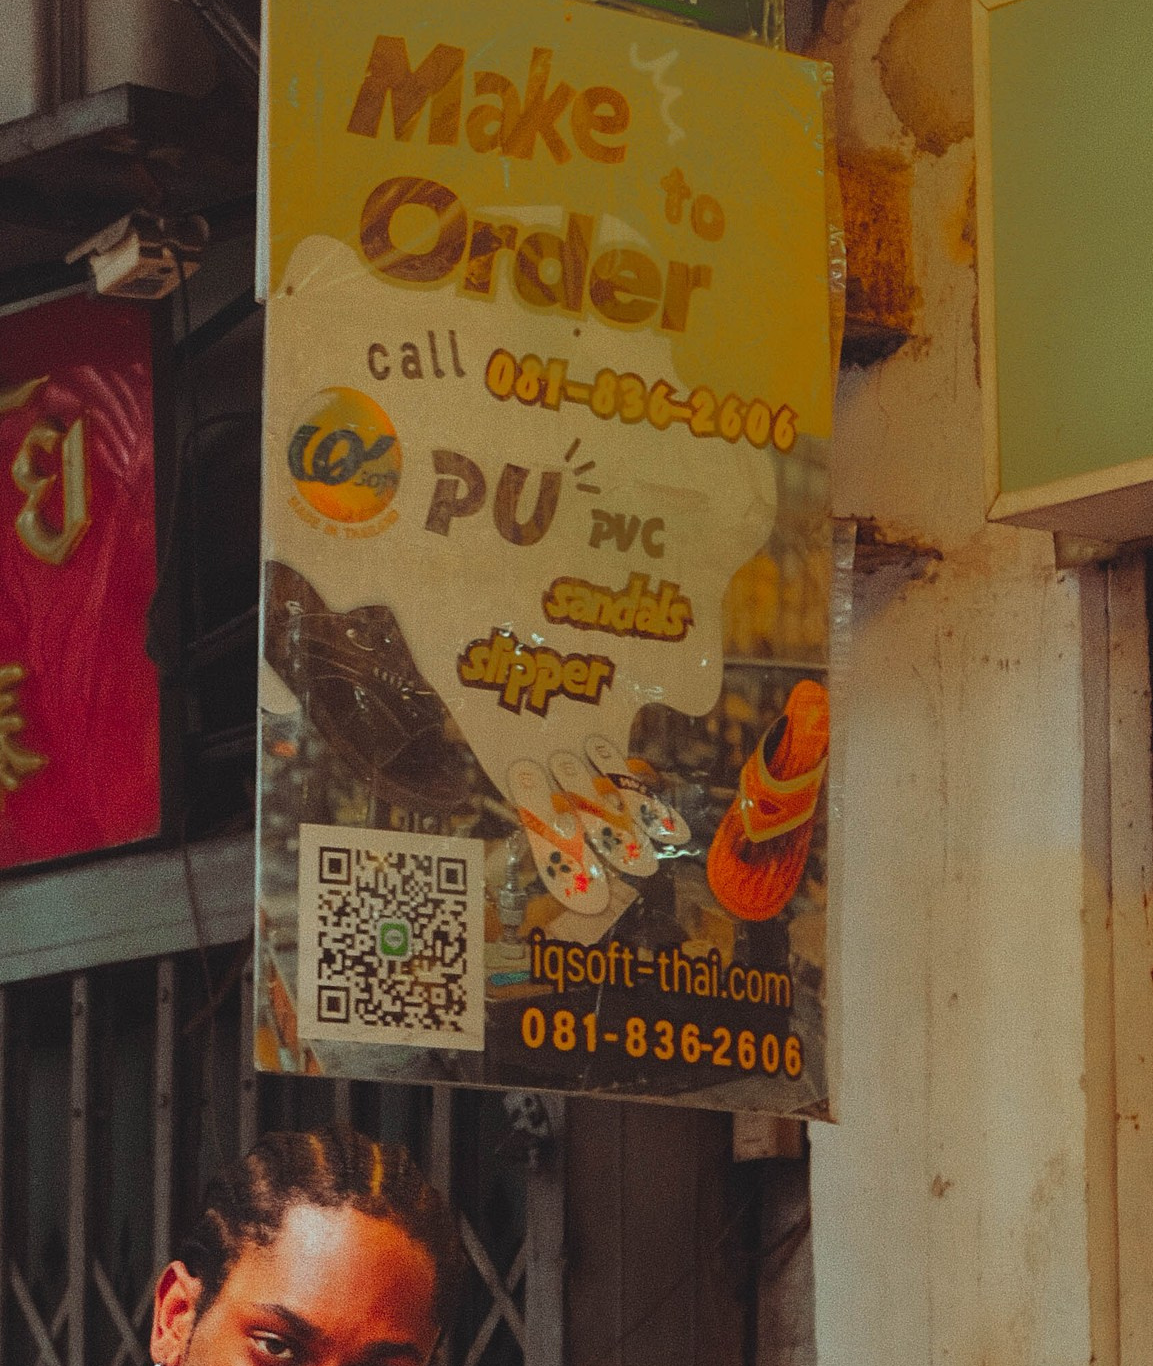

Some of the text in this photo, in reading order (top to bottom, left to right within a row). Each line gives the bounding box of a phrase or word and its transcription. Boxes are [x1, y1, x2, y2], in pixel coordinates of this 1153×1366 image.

[347, 34, 632, 165] Make
[660, 167, 726, 243] to
[358, 175, 713, 333] Order
[366, 329, 798, 453] call 081-836-2606
[424, 448, 562, 547] PU
[588, 508, 666, 558] PVC
[542, 571, 694, 643] sandals
[457, 626, 616, 718] slipper
[530, 934, 793, 1007] iqsoft-thai.com
[520, 1007, 803, 1076] 081-836-2606
